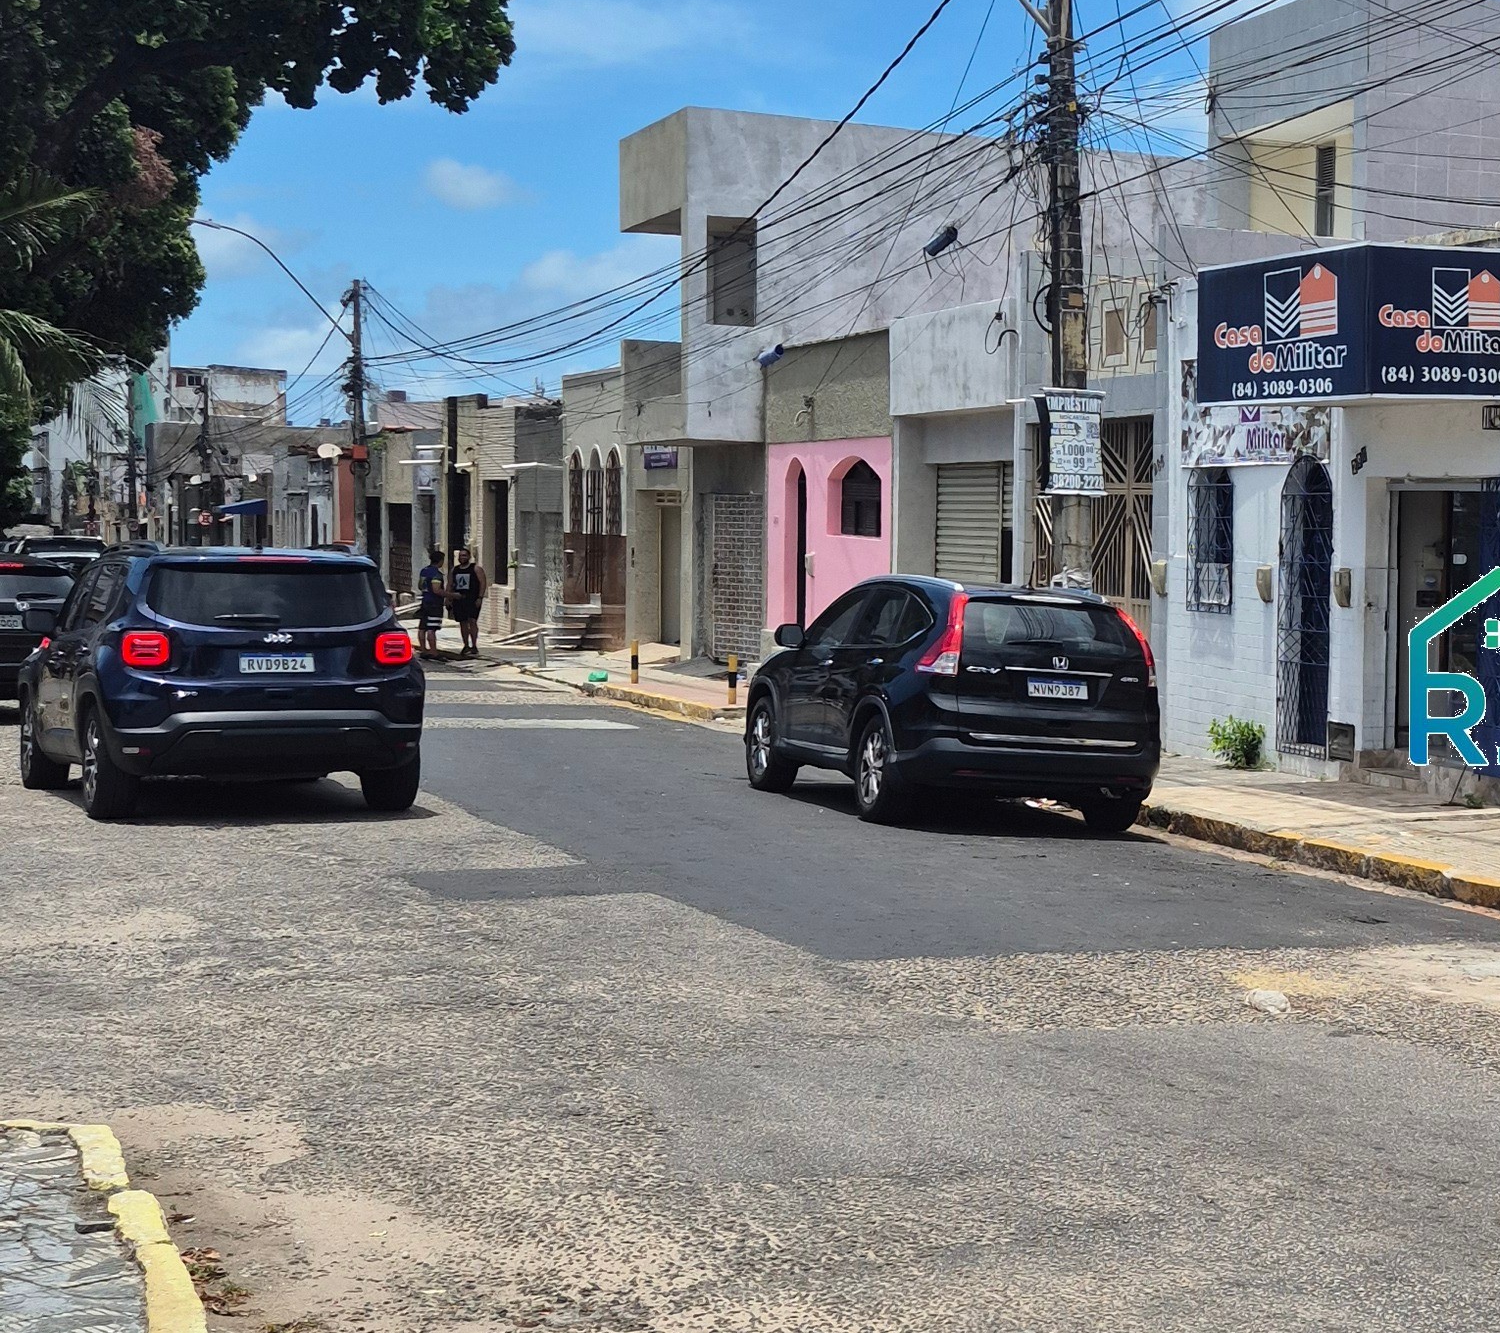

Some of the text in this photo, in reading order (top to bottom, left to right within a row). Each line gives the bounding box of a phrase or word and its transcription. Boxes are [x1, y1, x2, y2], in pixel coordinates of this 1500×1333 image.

[1378, 304, 1431, 329] Casa
[1214, 322, 1263, 349] Casa
[1381, 366, 1415, 384] (84)
[1232, 378, 1333, 399] (84) 3089-0306
[1246, 427, 1286, 451] Militar
[263, 633, 293, 644] Jeep
[247, 658, 307, 671] RVD9B24
[1033, 684, 1081, 697] NVN9J87
